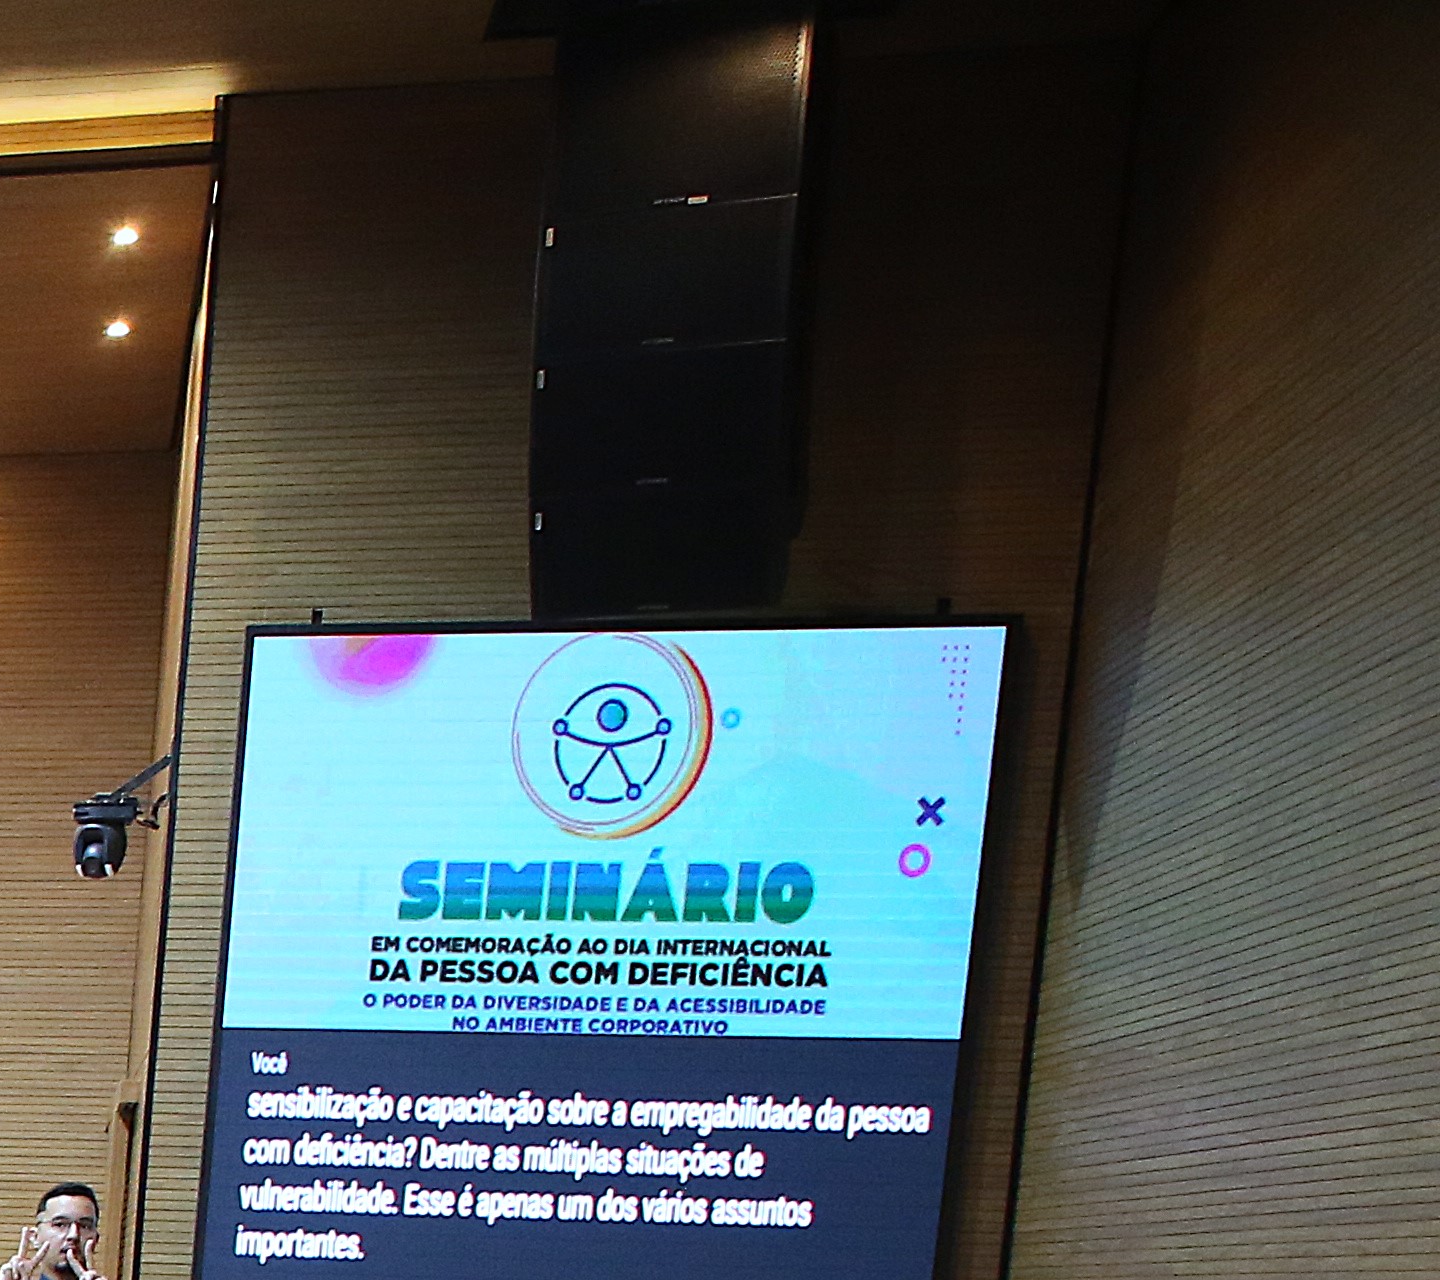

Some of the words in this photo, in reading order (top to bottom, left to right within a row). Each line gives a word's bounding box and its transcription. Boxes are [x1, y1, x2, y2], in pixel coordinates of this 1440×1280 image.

[398, 846, 814, 924] SEMINÁRIO
[371, 936, 400, 952] EM
[406, 934, 571, 956] COMEMORAÇÃO
[577, 939, 608, 954] AO
[614, 939, 649, 955] DIA
[657, 939, 831, 956] INTERNACIONAL
[369, 959, 411, 982] DA
[420, 960, 539, 983] PESSOA
[549, 961, 619, 985] COM
[628, 956, 828, 987] DEFICIÊNCIA
[363, 994, 376, 1007] O
[383, 994, 445, 1009] PODER
[451, 995, 477, 1009] DA
[483, 995, 611, 1012] DIVERSIDADE
[617, 997, 628, 1011] E
[634, 998, 659, 1012] DA
[666, 998, 826, 1015] ACESSIBILIDADE
[452, 1016, 479, 1030] NO
[486, 1017, 582, 1032] AMBIENTE
[589, 1019, 728, 1034] CORPORATIVO
[251, 1052, 288, 1074] Você
[247, 1085, 394, 1128] sensibilização
[396, 1095, 413, 1121] e
[414, 1090, 544, 1130] capacitação
[546, 1092, 610, 1125] sobre
[611, 1100, 627, 1126] a
[630, 1093, 812, 1135] empregabilidade
[815, 1096, 845, 1131] da
[846, 1106, 931, 1139] pessoa
[243, 1138, 290, 1164] com
[294, 1132, 418, 1168] deficiência?
[419, 1136, 490, 1170] Dentre
[493, 1145, 520, 1171] as
[523, 1139, 623, 1181] múltiplas
[625, 1142, 731, 1183] situações
[734, 1144, 765, 1177] de
[239, 1178, 399, 1215] vulnerabilidade.
[402, 1182, 456, 1216] Esse
[458, 1183, 474, 1217] é
[475, 1192, 554, 1225] apenas
[557, 1195, 594, 1221] um
[596, 1188, 638, 1222] dos
[642, 1189, 708, 1224] vários
[710, 1196, 813, 1227] assuntos
[235, 1225, 365, 1265] importantes.
